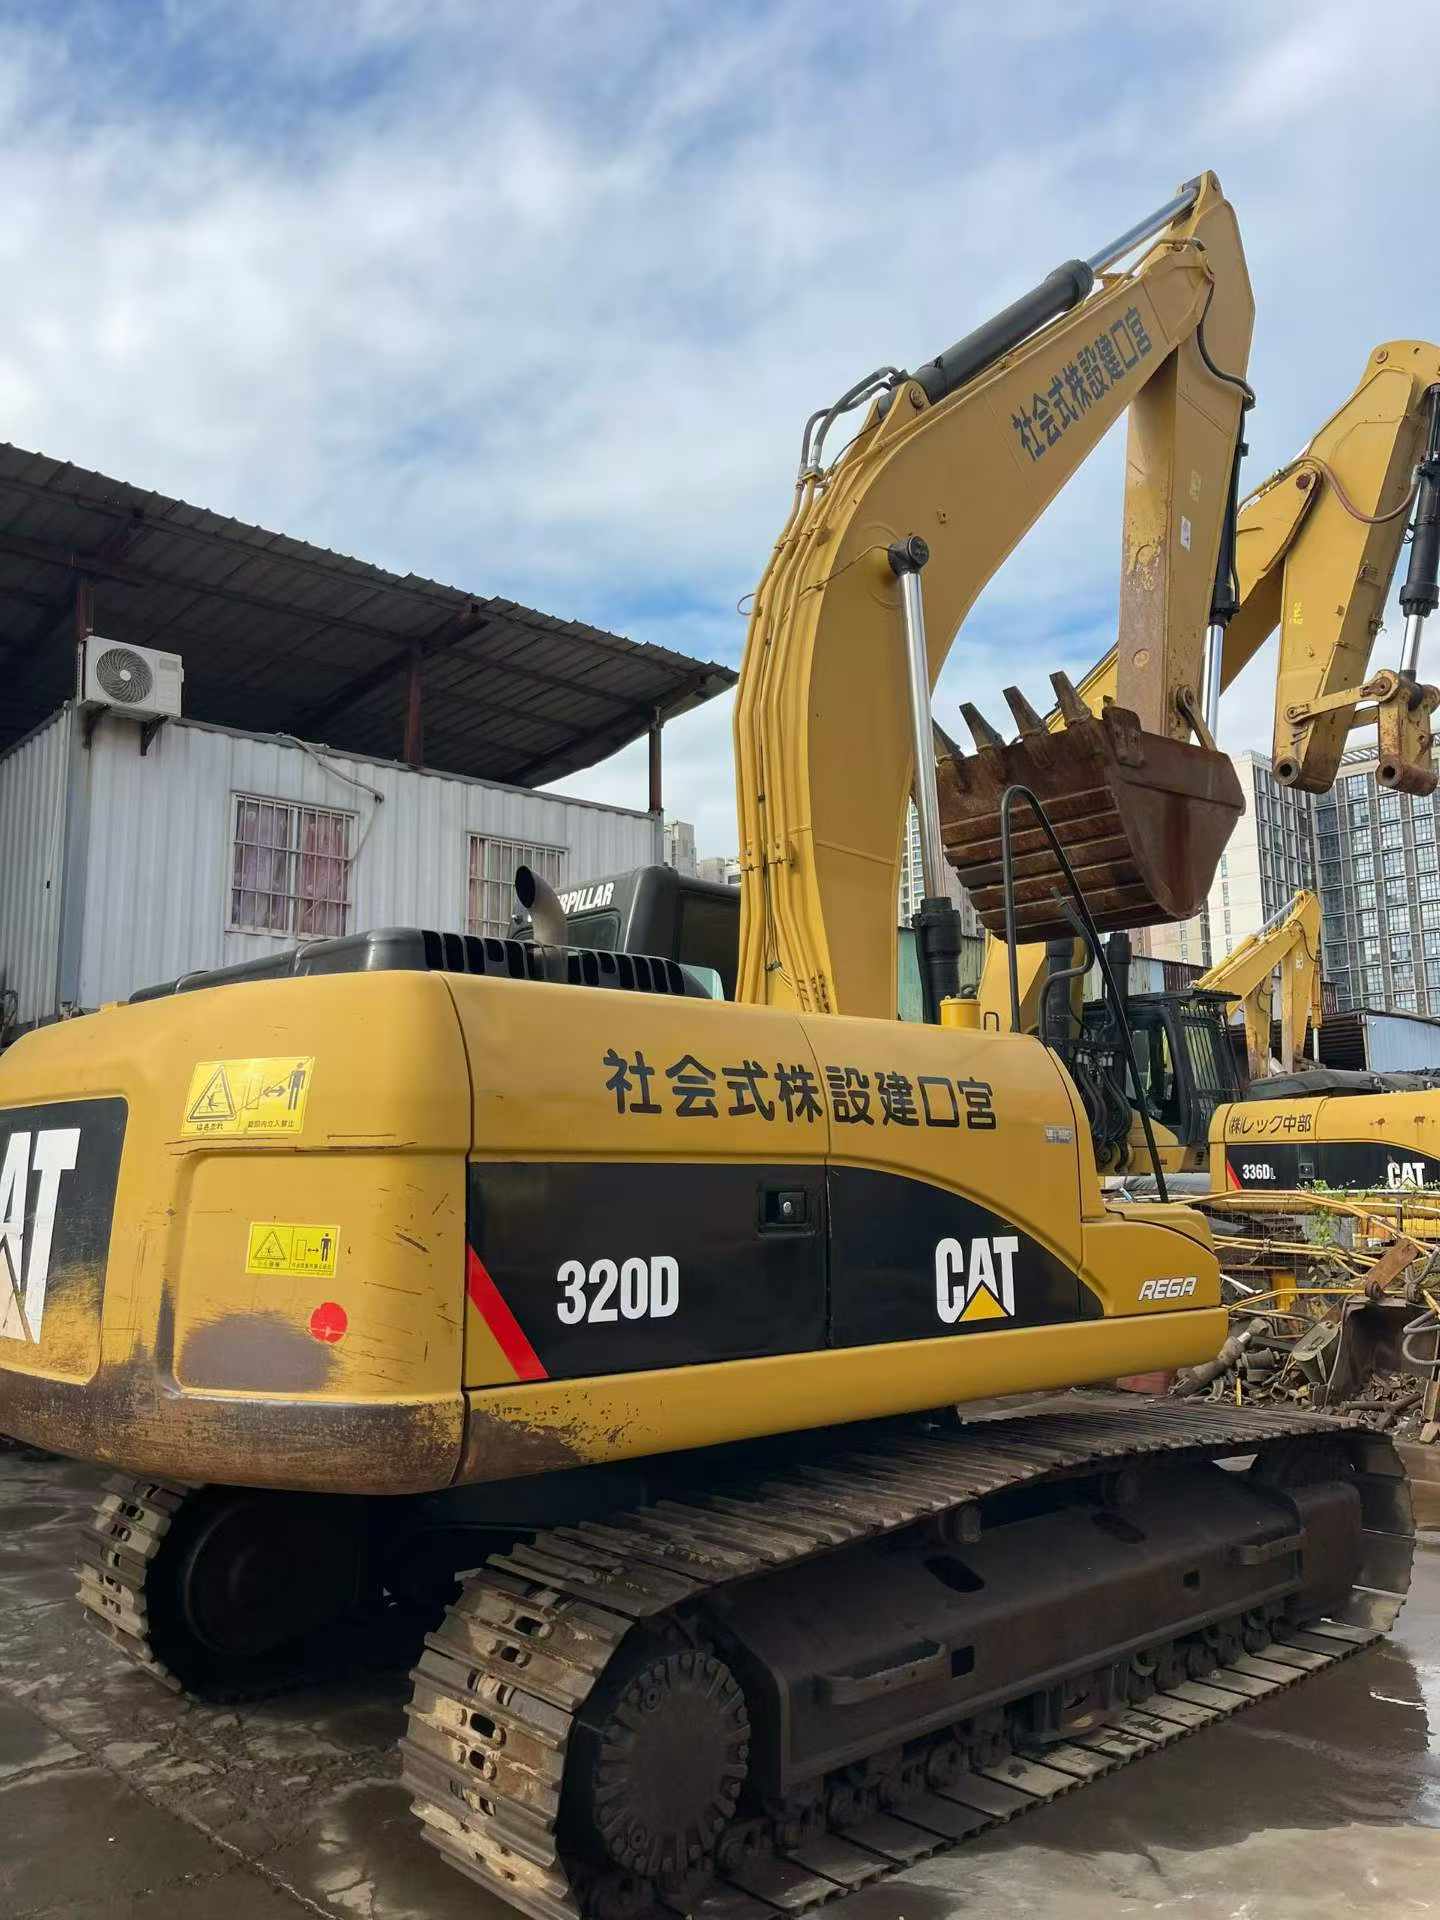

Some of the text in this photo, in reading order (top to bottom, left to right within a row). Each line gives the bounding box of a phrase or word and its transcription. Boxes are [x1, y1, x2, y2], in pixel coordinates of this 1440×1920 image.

[557, 882, 615, 914] RPILLAR
[603, 1048, 997, 1130] 社会式株設建口宮
[1387, 1162, 1425, 1189] CAT
[0, 1128, 81, 1344] AT
[556, 1255, 679, 1325] 320D
[935, 1236, 1019, 1324] CAT
[1138, 1277, 1197, 1301] REGA
